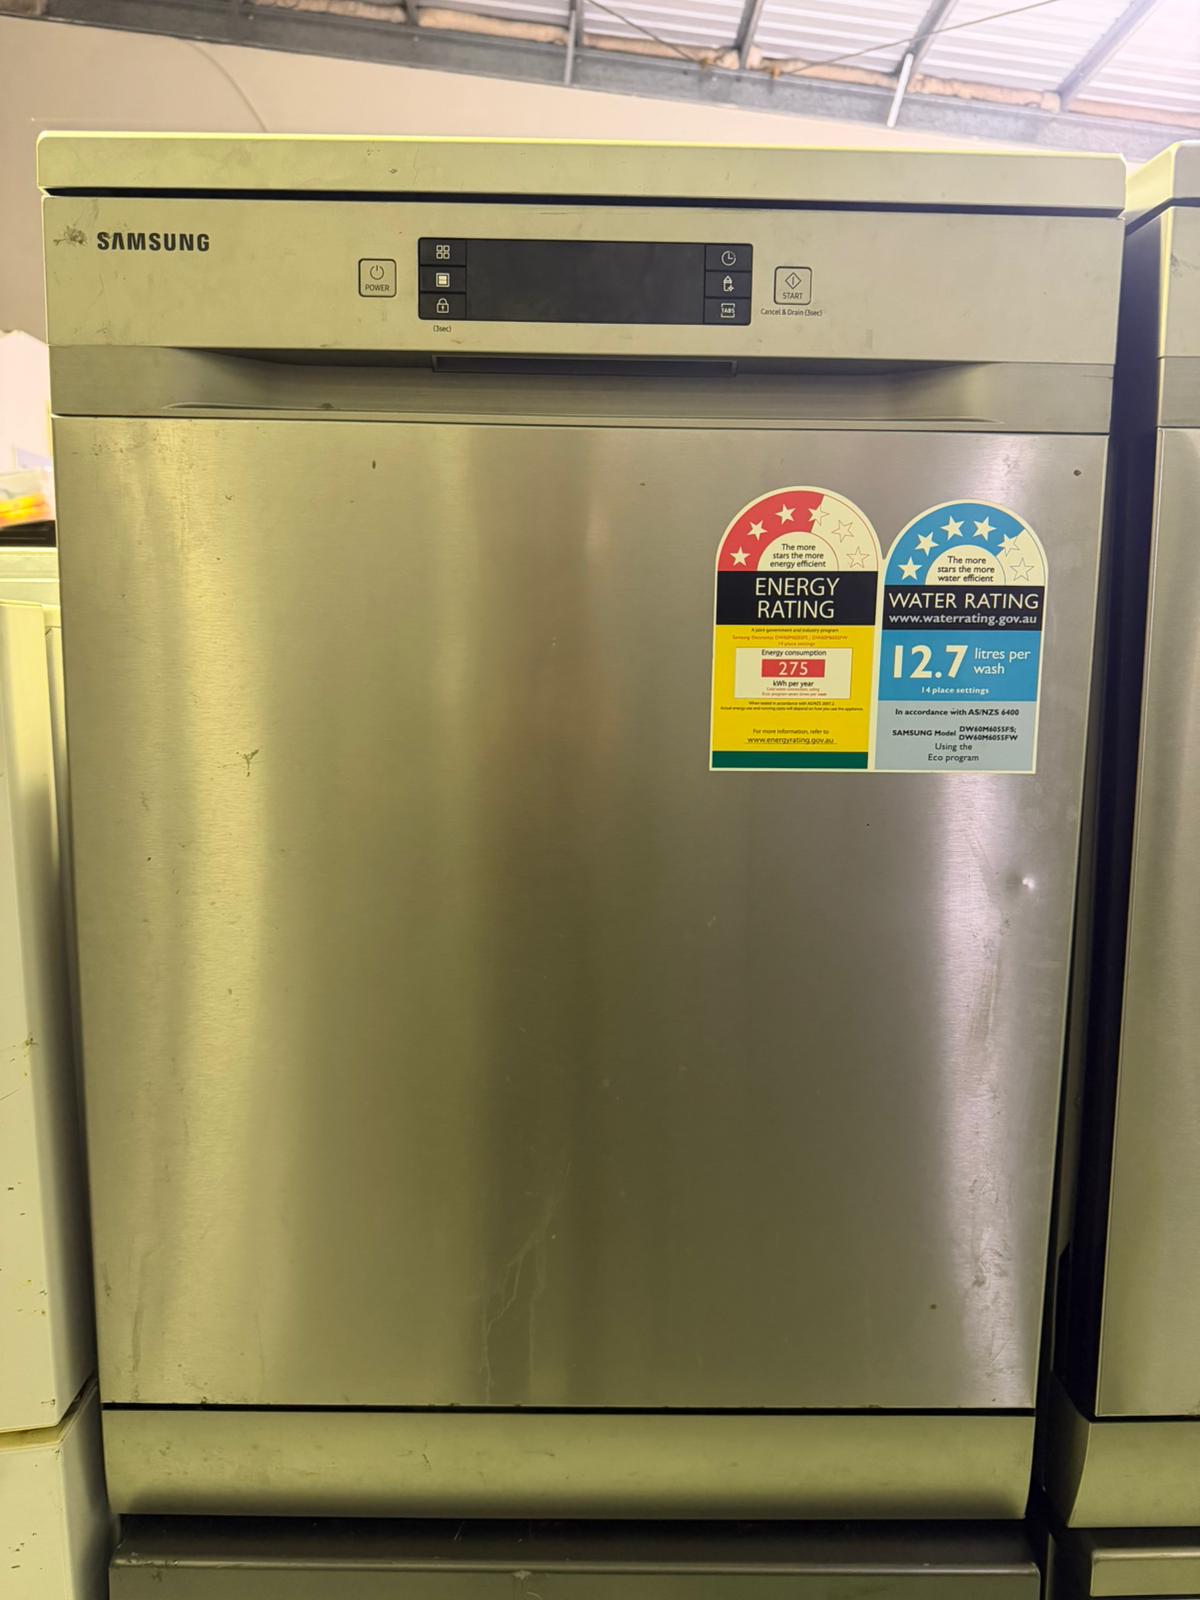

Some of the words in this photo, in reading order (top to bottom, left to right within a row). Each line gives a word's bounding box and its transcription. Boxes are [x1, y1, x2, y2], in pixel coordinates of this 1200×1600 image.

[96, 232, 210, 251] SAMSUNG
[365, 284, 390, 292] POWER
[782, 543, 795, 551] The
[796, 543, 816, 551] more
[770, 561, 795, 569] energy
[796, 560, 826, 568] efficient
[947, 556, 963, 564] The
[965, 556, 986, 564] more
[963, 574, 993, 582] efficient
[755, 577, 840, 596] ENERGY
[888, 593, 957, 609] WATER
[964, 593, 1039, 609] RATING
[757, 600, 835, 619] RATING
[888, 613, 1037, 626] www.waterrating.gov.au
[761, 649, 783, 657] Energy
[785, 649, 827, 657] consumption
[974, 647, 1005, 660] litres
[1008, 650, 1031, 663] per
[893, 645, 968, 679] 12.7
[779, 661, 808, 676] 275
[973, 663, 1005, 675] wash
[921, 686, 931, 696] 14
[932, 686, 955, 696] place
[956, 686, 989, 696] settings
[895, 708, 903, 716] In
[904, 708, 948, 716] accordance
[950, 708, 967, 716] with
[968, 708, 999, 716] AS/NZS
[1001, 708, 1019, 716] 6400
[935, 743, 957, 752] Using
[959, 743, 973, 752] the
[928, 753, 943, 761] Eco
[945, 755, 980, 763] program
